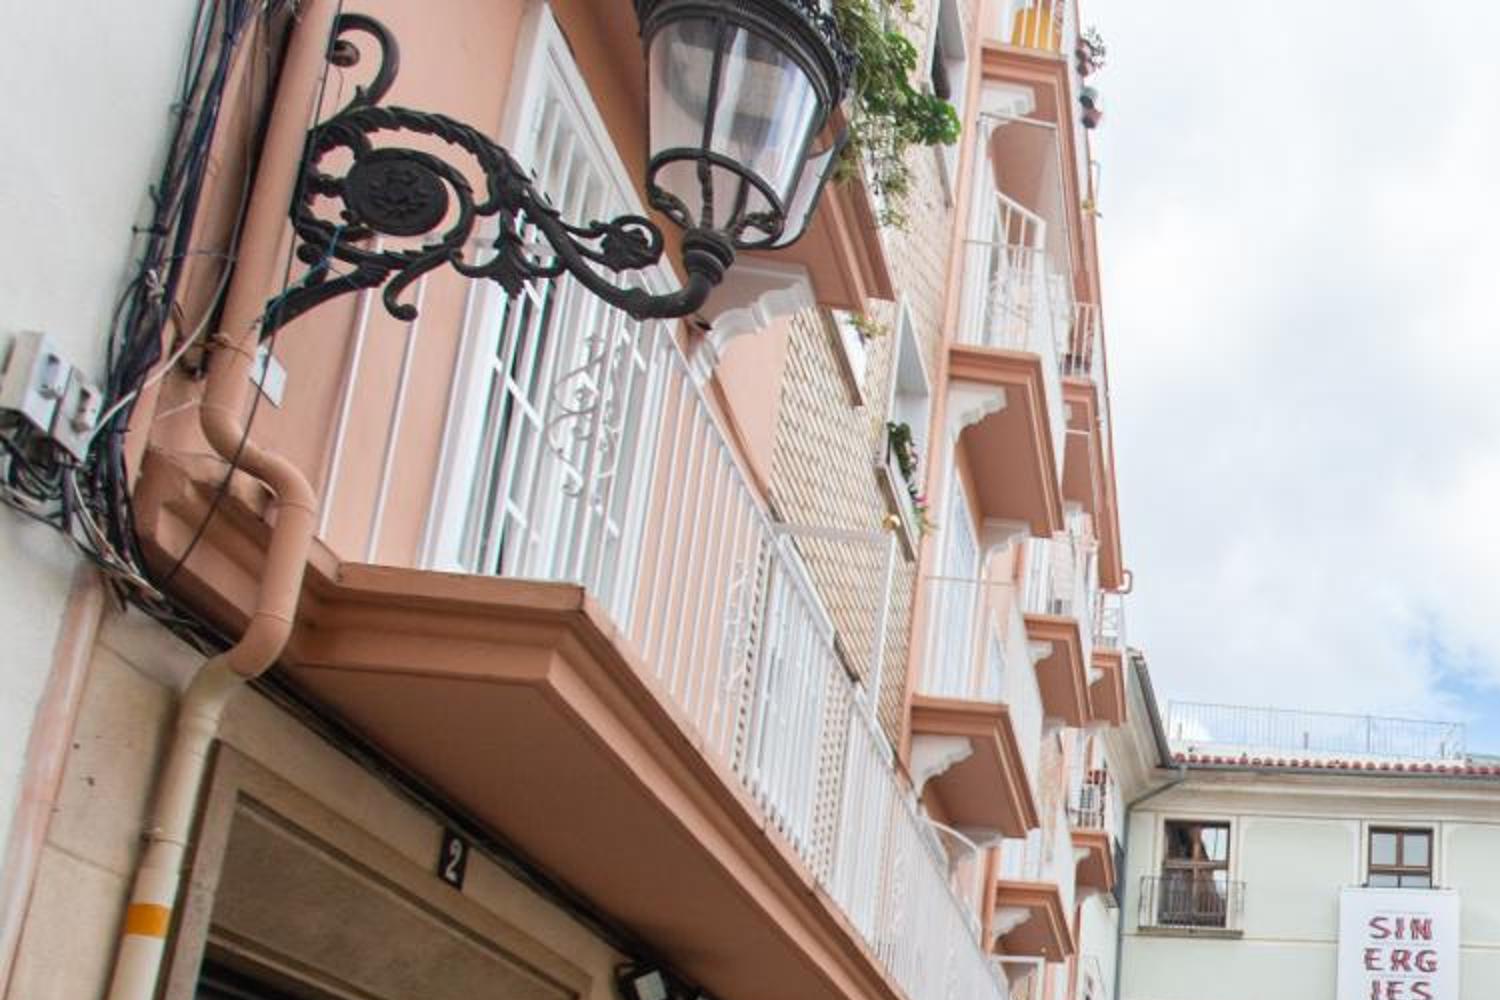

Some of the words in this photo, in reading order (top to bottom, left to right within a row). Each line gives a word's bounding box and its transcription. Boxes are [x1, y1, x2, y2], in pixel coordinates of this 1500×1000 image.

[445, 838, 463, 881] 2
[1368, 915, 1433, 941] SIN
[1363, 946, 1438, 973] ERG
